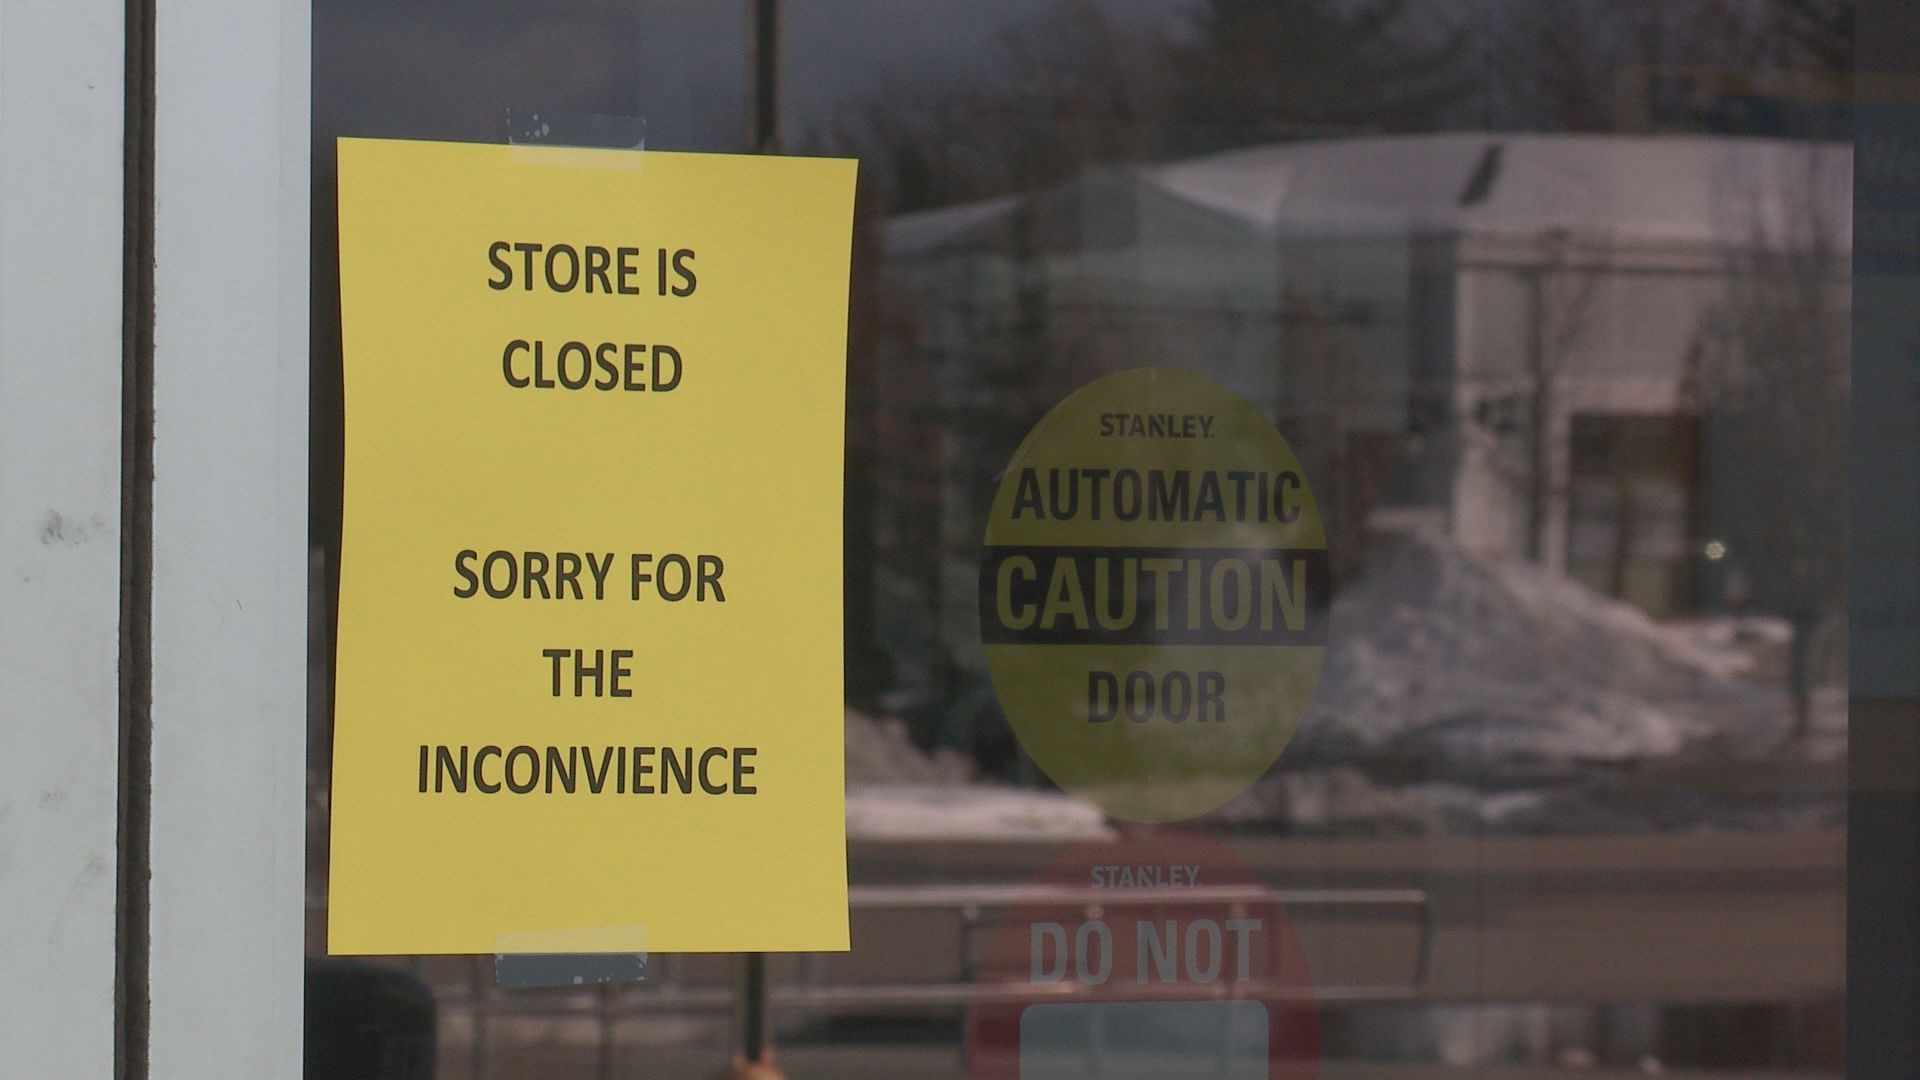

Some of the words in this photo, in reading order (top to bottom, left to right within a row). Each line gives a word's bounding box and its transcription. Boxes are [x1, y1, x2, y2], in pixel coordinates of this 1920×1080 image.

[488, 241, 640, 296] STORE
[658, 248, 697, 298] IS
[502, 340, 683, 393] CLOSED
[1099, 412, 1215, 439] STANLEY
[1010, 467, 1301, 523] AUTOMATIC
[453, 549, 615, 601] SORRY
[631, 553, 726, 603] FOR
[996, 555, 1307, 632] CAUTION
[542, 649, 634, 698] THE
[1088, 670, 1226, 724] DOOR
[418, 745, 758, 796] INCONVIENCE
[1090, 865, 1200, 889] STANLEY
[1030, 920, 1113, 986] DO
[1136, 918, 1263, 984] NOT
